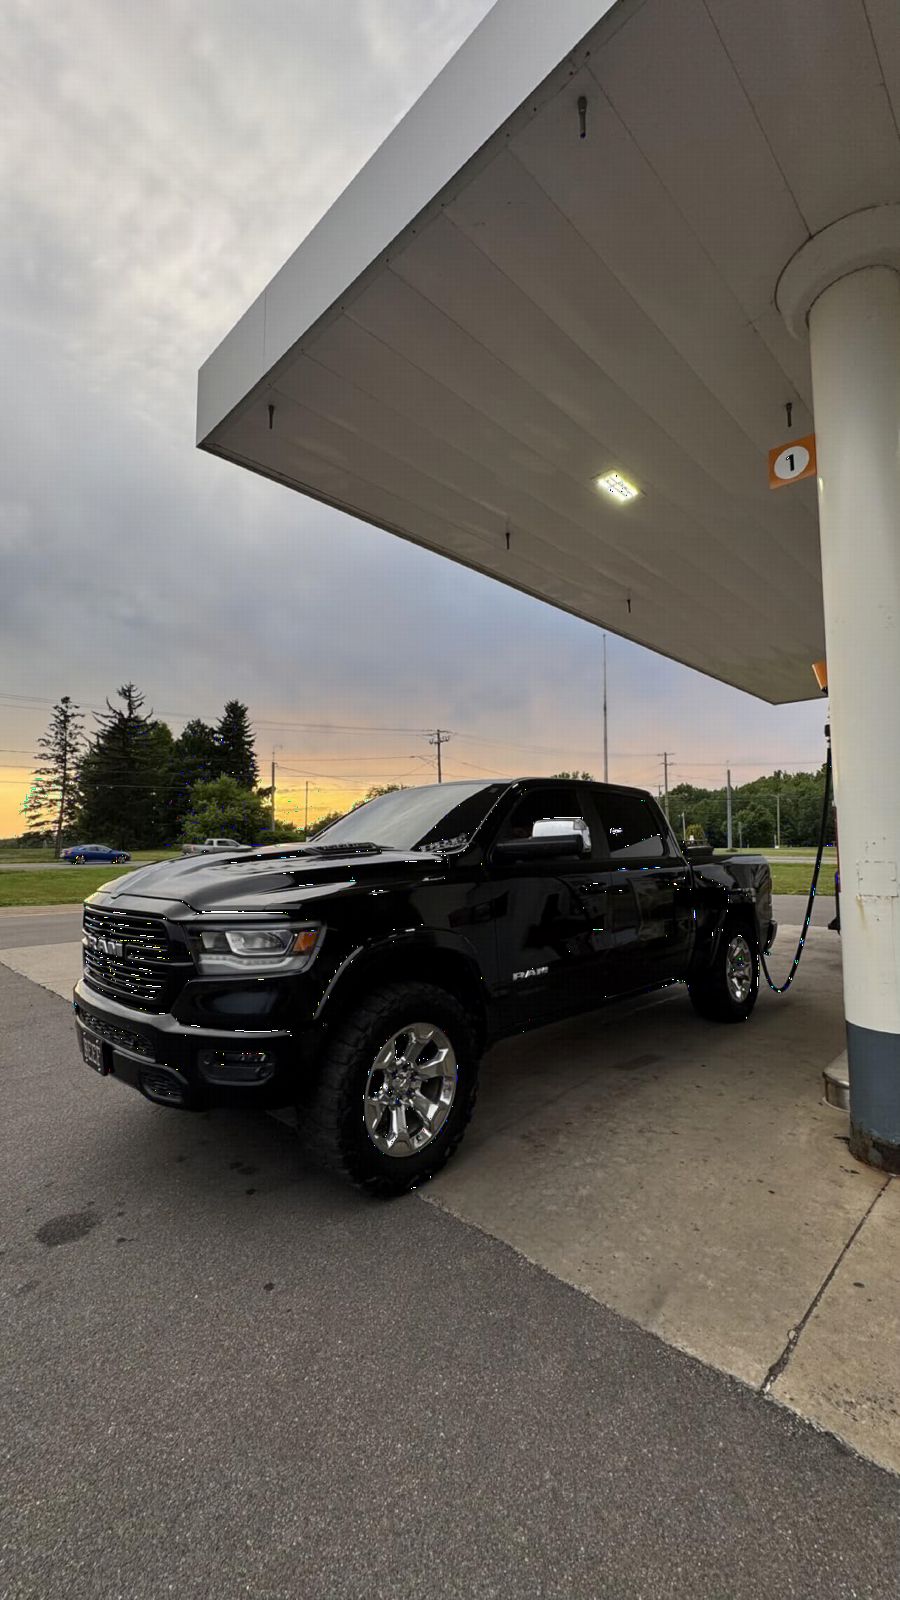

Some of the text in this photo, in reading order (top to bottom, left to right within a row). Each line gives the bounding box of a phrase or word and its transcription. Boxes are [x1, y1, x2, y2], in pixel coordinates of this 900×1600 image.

[786, 453, 795, 471] 1
[87, 935, 123, 957] RAM
[512, 966, 549, 981] RAM
